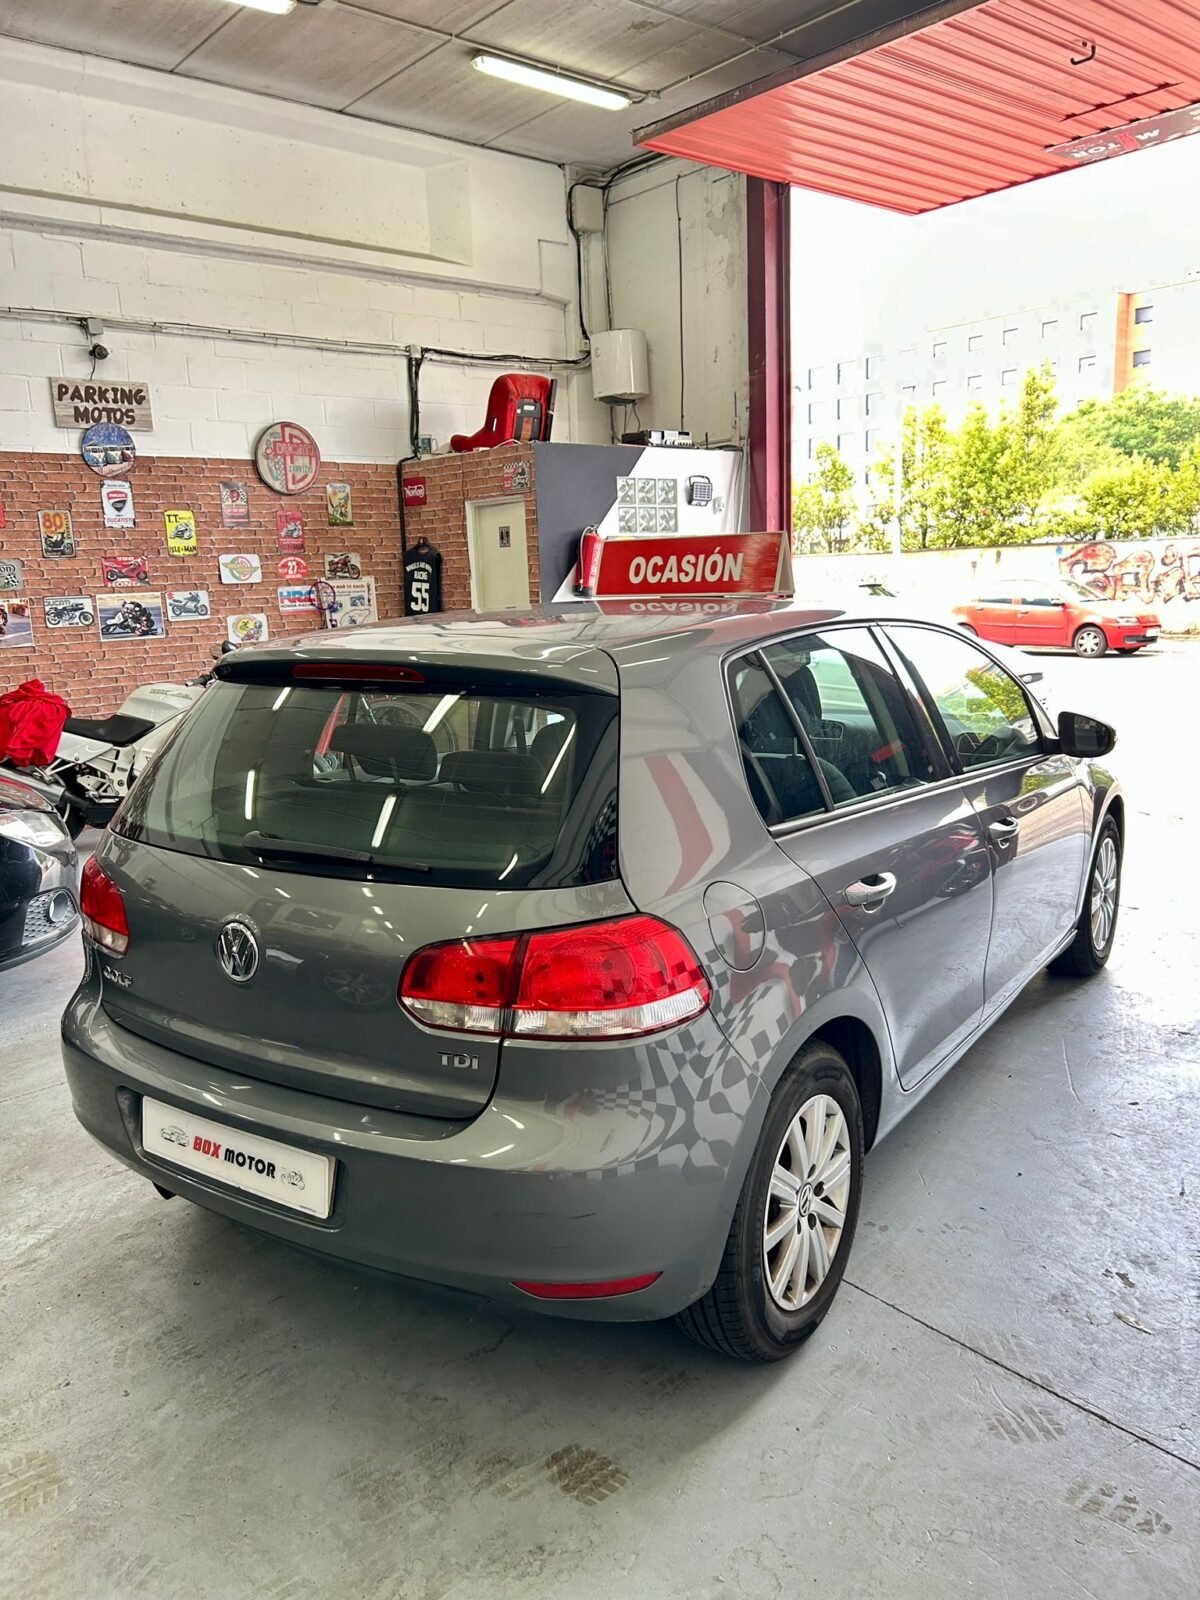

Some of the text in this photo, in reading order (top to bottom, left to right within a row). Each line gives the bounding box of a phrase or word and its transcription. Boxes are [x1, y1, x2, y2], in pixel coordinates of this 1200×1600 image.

[57, 383, 146, 405] PARKING
[74, 405, 136, 425] MOTOS
[275, 442, 314, 456] DUCATI
[629, 547, 744, 584] OCASIÓN
[410, 581, 430, 612] 55
[103, 965, 132, 987] GOLF
[437, 1051, 479, 1070] TDI
[192, 1135, 276, 1179] BOX MOTOR
